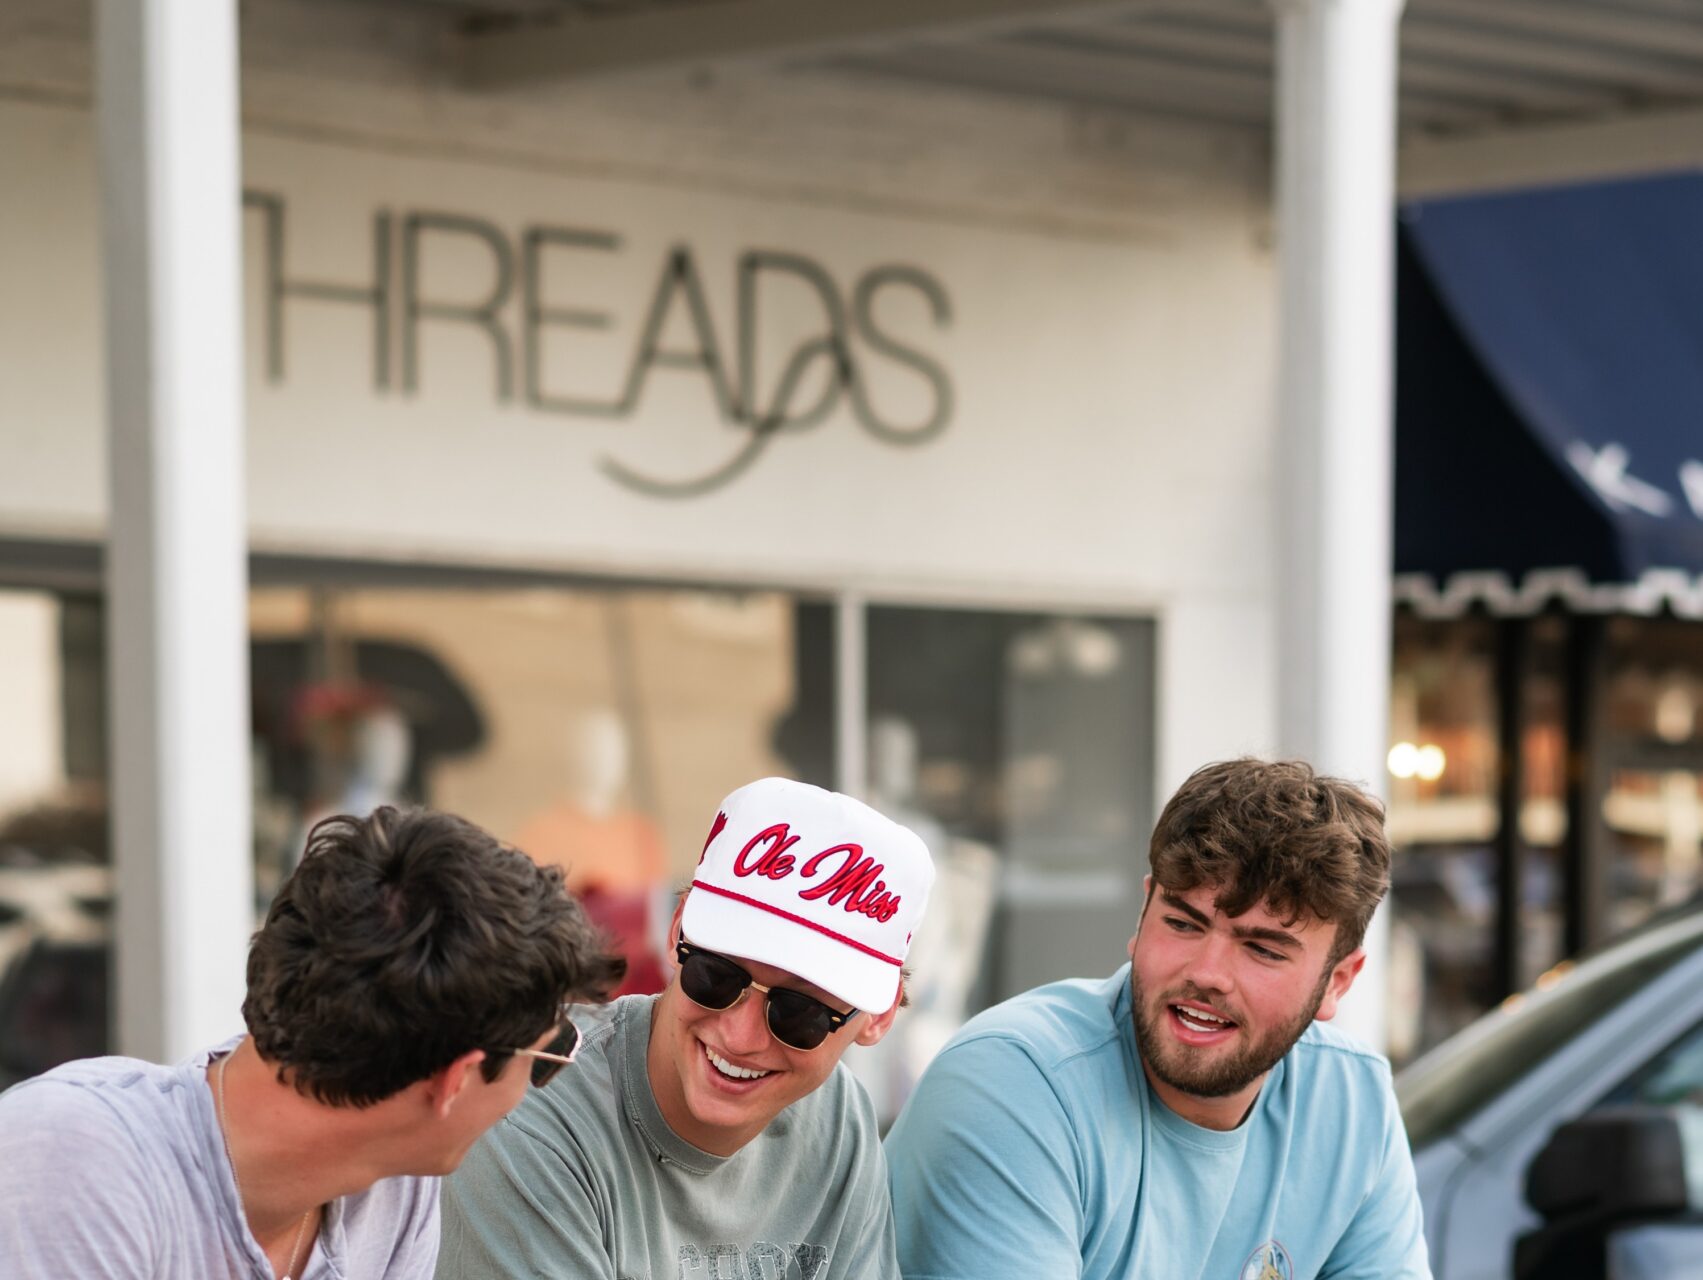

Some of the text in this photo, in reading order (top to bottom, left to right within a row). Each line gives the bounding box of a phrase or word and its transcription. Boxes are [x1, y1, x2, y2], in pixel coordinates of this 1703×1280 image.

[243, 187, 955, 501] HREADS
[734, 823, 901, 922] Ole Miss
